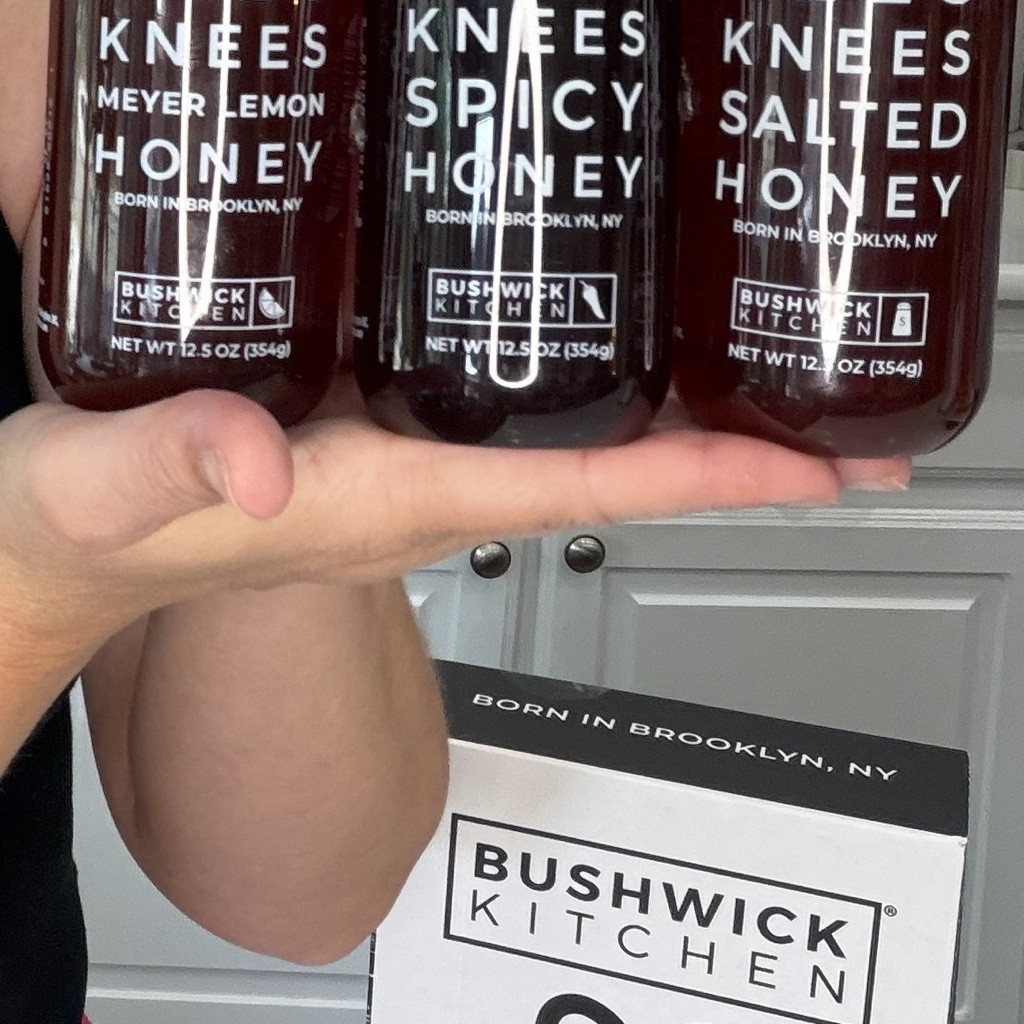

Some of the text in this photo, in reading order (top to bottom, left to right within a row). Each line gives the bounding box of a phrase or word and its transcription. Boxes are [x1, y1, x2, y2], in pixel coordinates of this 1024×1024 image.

[99, 16, 327, 69] KNEES
[407, 7, 646, 57] KNEES
[723, 18, 971, 76] KNEES
[97, 86, 325, 118] MEYER LEMON
[405, 77, 644, 132] SPICY
[719, 89, 968, 150] SALTED
[94, 133, 323, 184] HONEY
[404, 151, 644, 199] HONEY
[114, 191, 159, 209] BORN
[162, 197, 180, 211] IN
[282, 197, 303, 212] NY
[715, 159, 963, 218] HONEY
[426, 209, 624, 230] BORN IN BROOKLYN, NY
[733, 218, 938, 251] BORN IN BROOKLYN, NY
[121, 281, 246, 304] BUSHCK
[435, 297, 565, 318] KITCHN
[436, 278, 565, 300] BUSHWICK
[740, 288, 872, 319] BUSHWCK
[120, 299, 246, 322] KITCEN
[111, 335, 292, 362] NET WT 12.5 OZ (354g)
[426, 335, 616, 361] NET WT 12.5 OZ (354g)
[728, 342, 923, 379] NET WT 12. OZ (354g)
[472, 693, 898, 781] BORN IN BROOKLYN, NY
[474, 842, 849, 958] BUSHWICK
[470, 888, 847, 1005] KITCHEN
